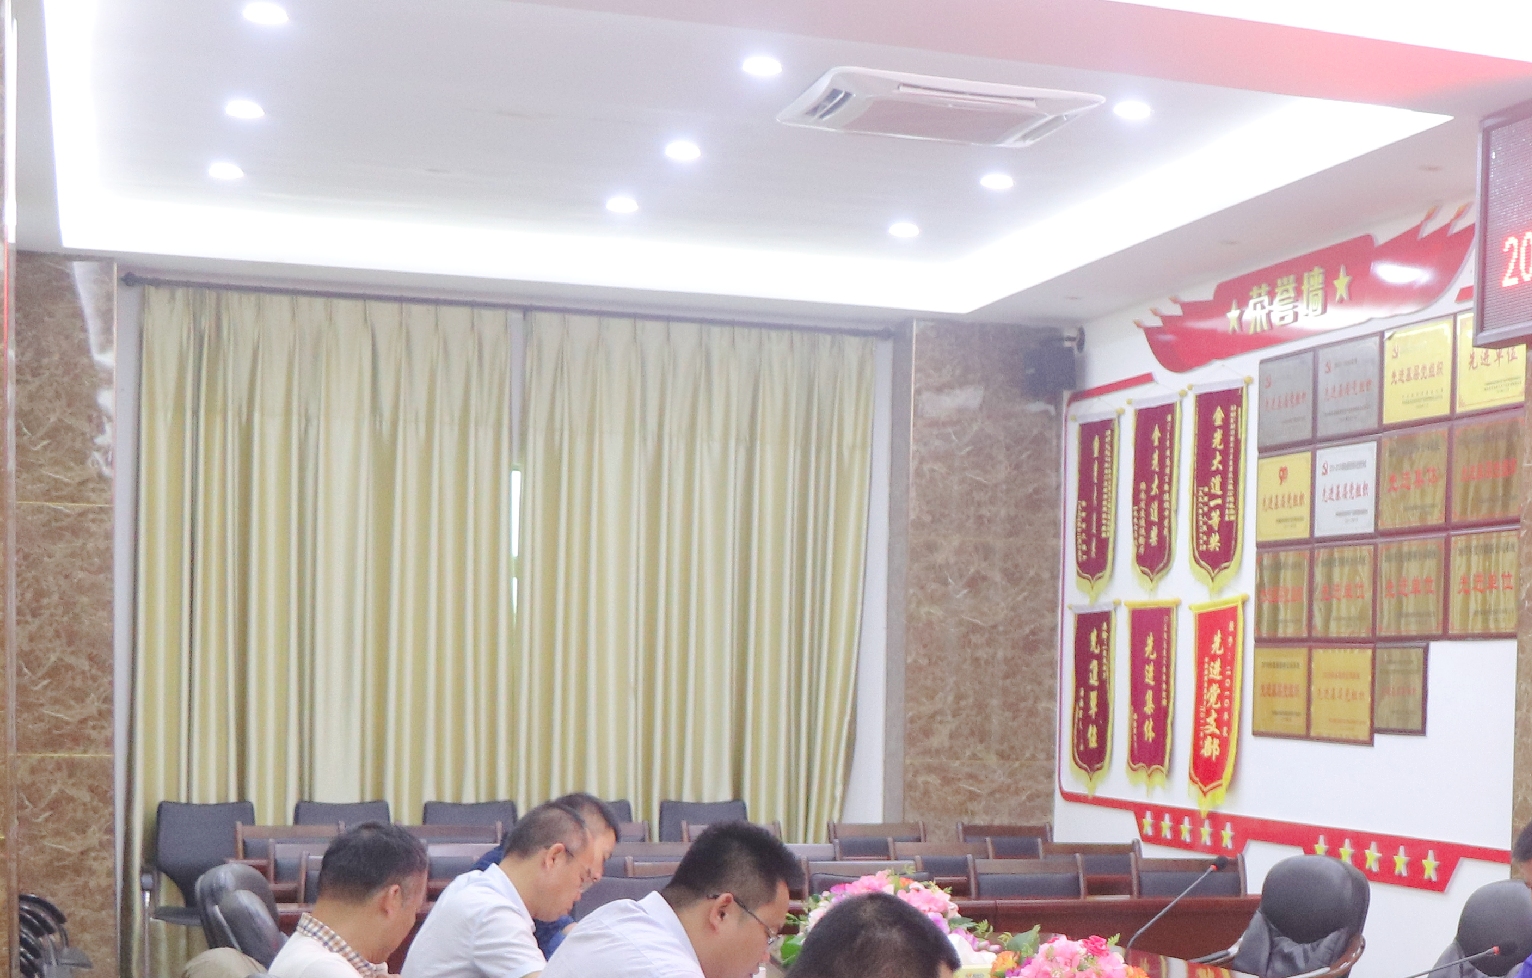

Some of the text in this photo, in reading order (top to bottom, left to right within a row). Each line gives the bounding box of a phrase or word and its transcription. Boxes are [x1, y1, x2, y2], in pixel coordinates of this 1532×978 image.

[1247, 265, 1326, 335] 荣誉墙
[1390, 361, 1444, 386] 先进基层党组织
[1143, 631, 1157, 743] 先进集体
[1201, 629, 1225, 761] 先进党支部
